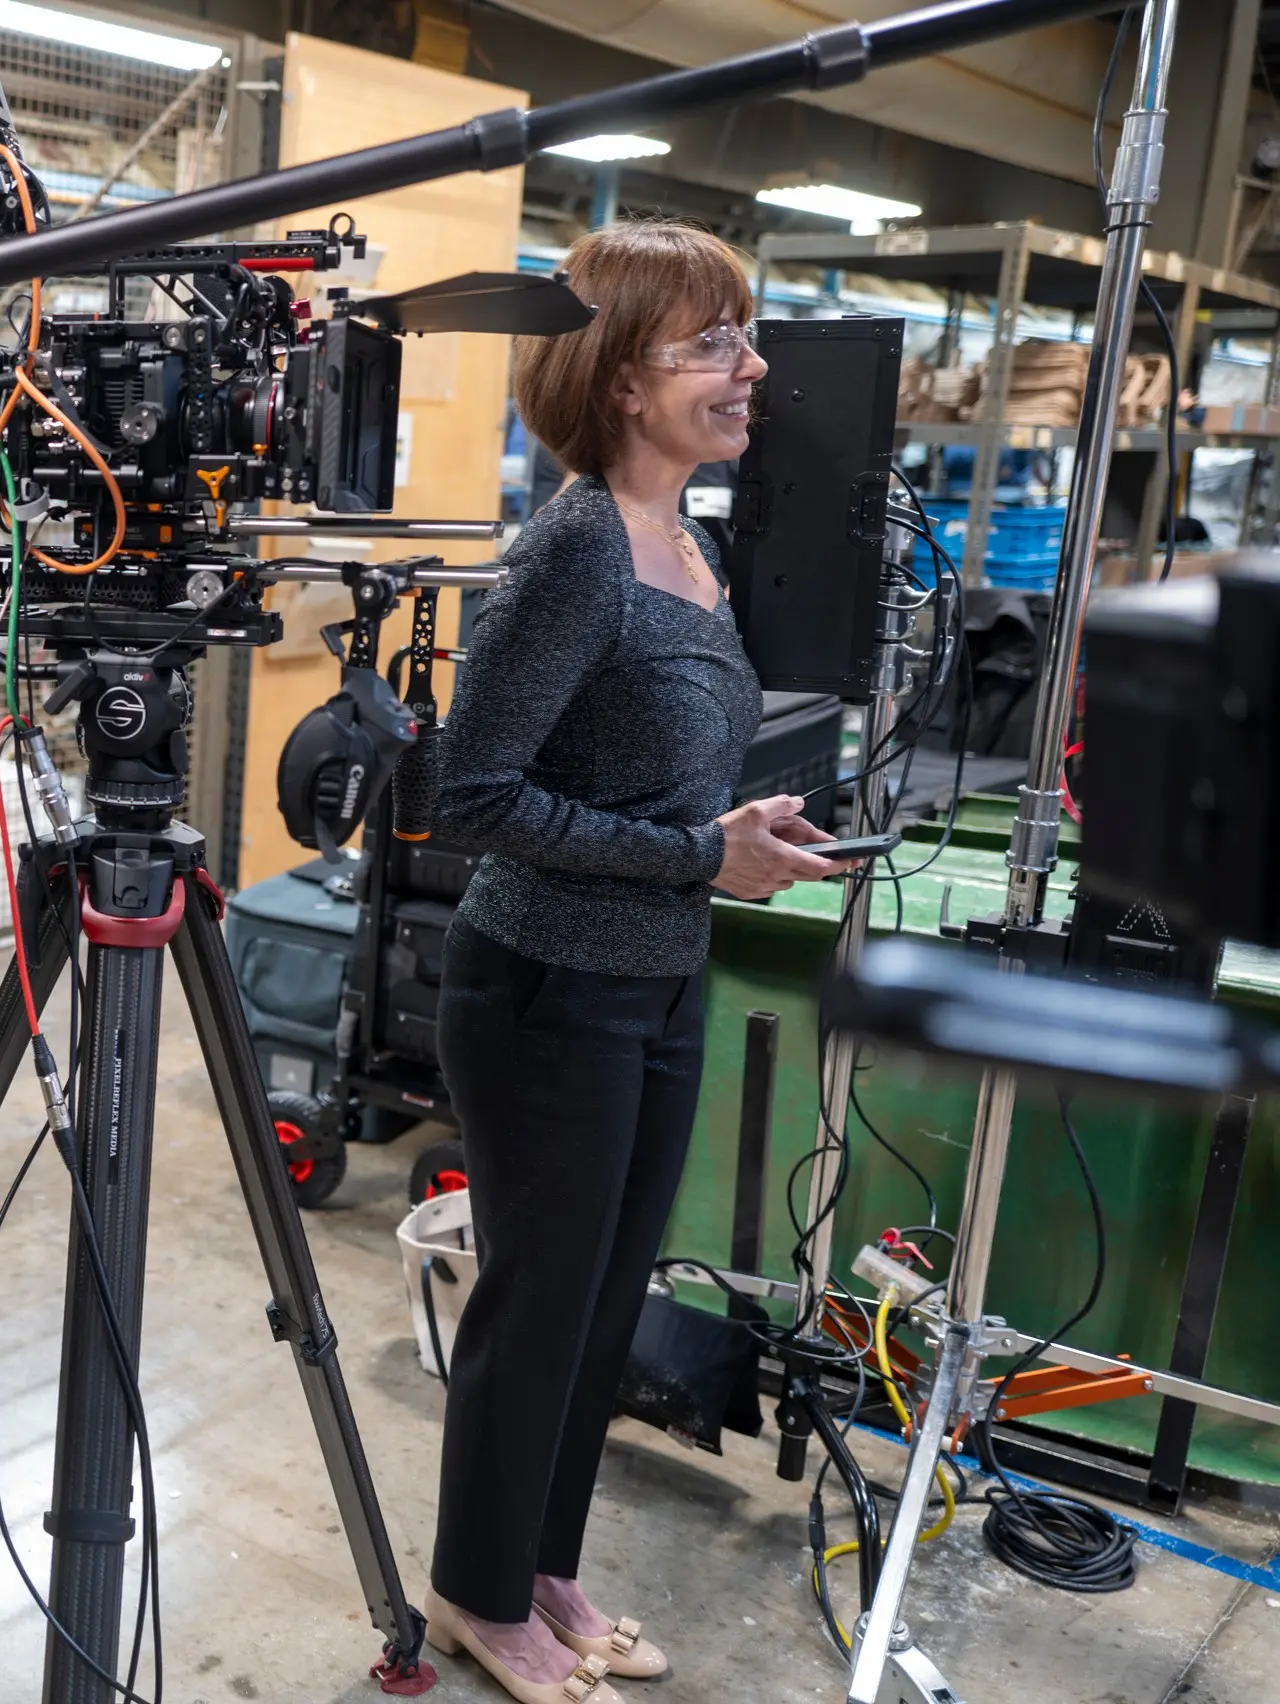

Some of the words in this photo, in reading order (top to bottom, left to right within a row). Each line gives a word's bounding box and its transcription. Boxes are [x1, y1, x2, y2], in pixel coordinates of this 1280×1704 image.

[340, 764, 365, 818] Canon
[111, 1056, 122, 1123] PIXELREFLEX
[109, 1126, 119, 1157] MEDIA
